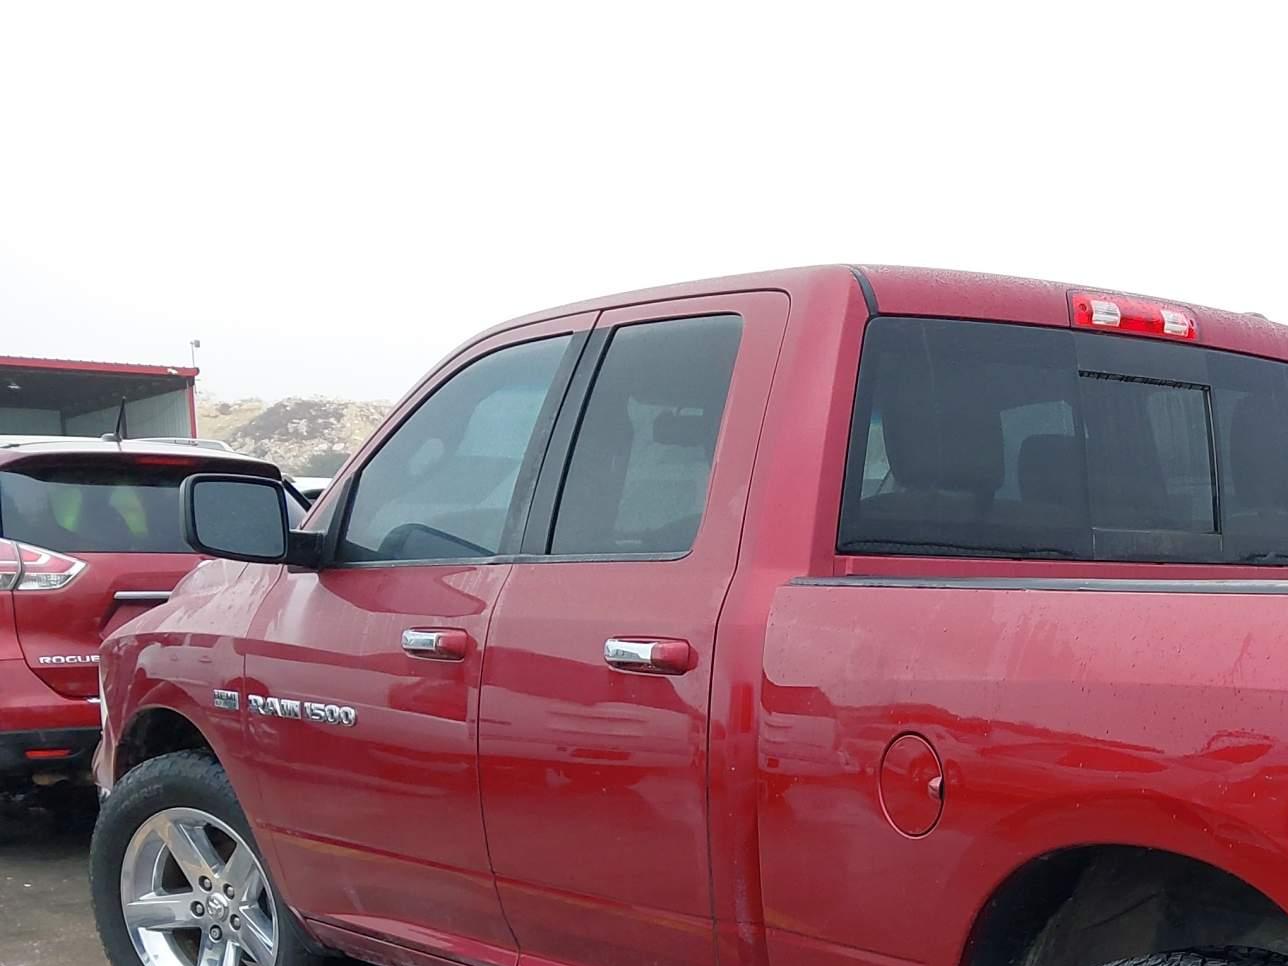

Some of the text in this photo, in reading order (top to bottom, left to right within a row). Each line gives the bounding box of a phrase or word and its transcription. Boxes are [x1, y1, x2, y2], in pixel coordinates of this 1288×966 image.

[39, 655, 100, 664] ROGUE
[248, 695, 357, 726] RAM 1500
